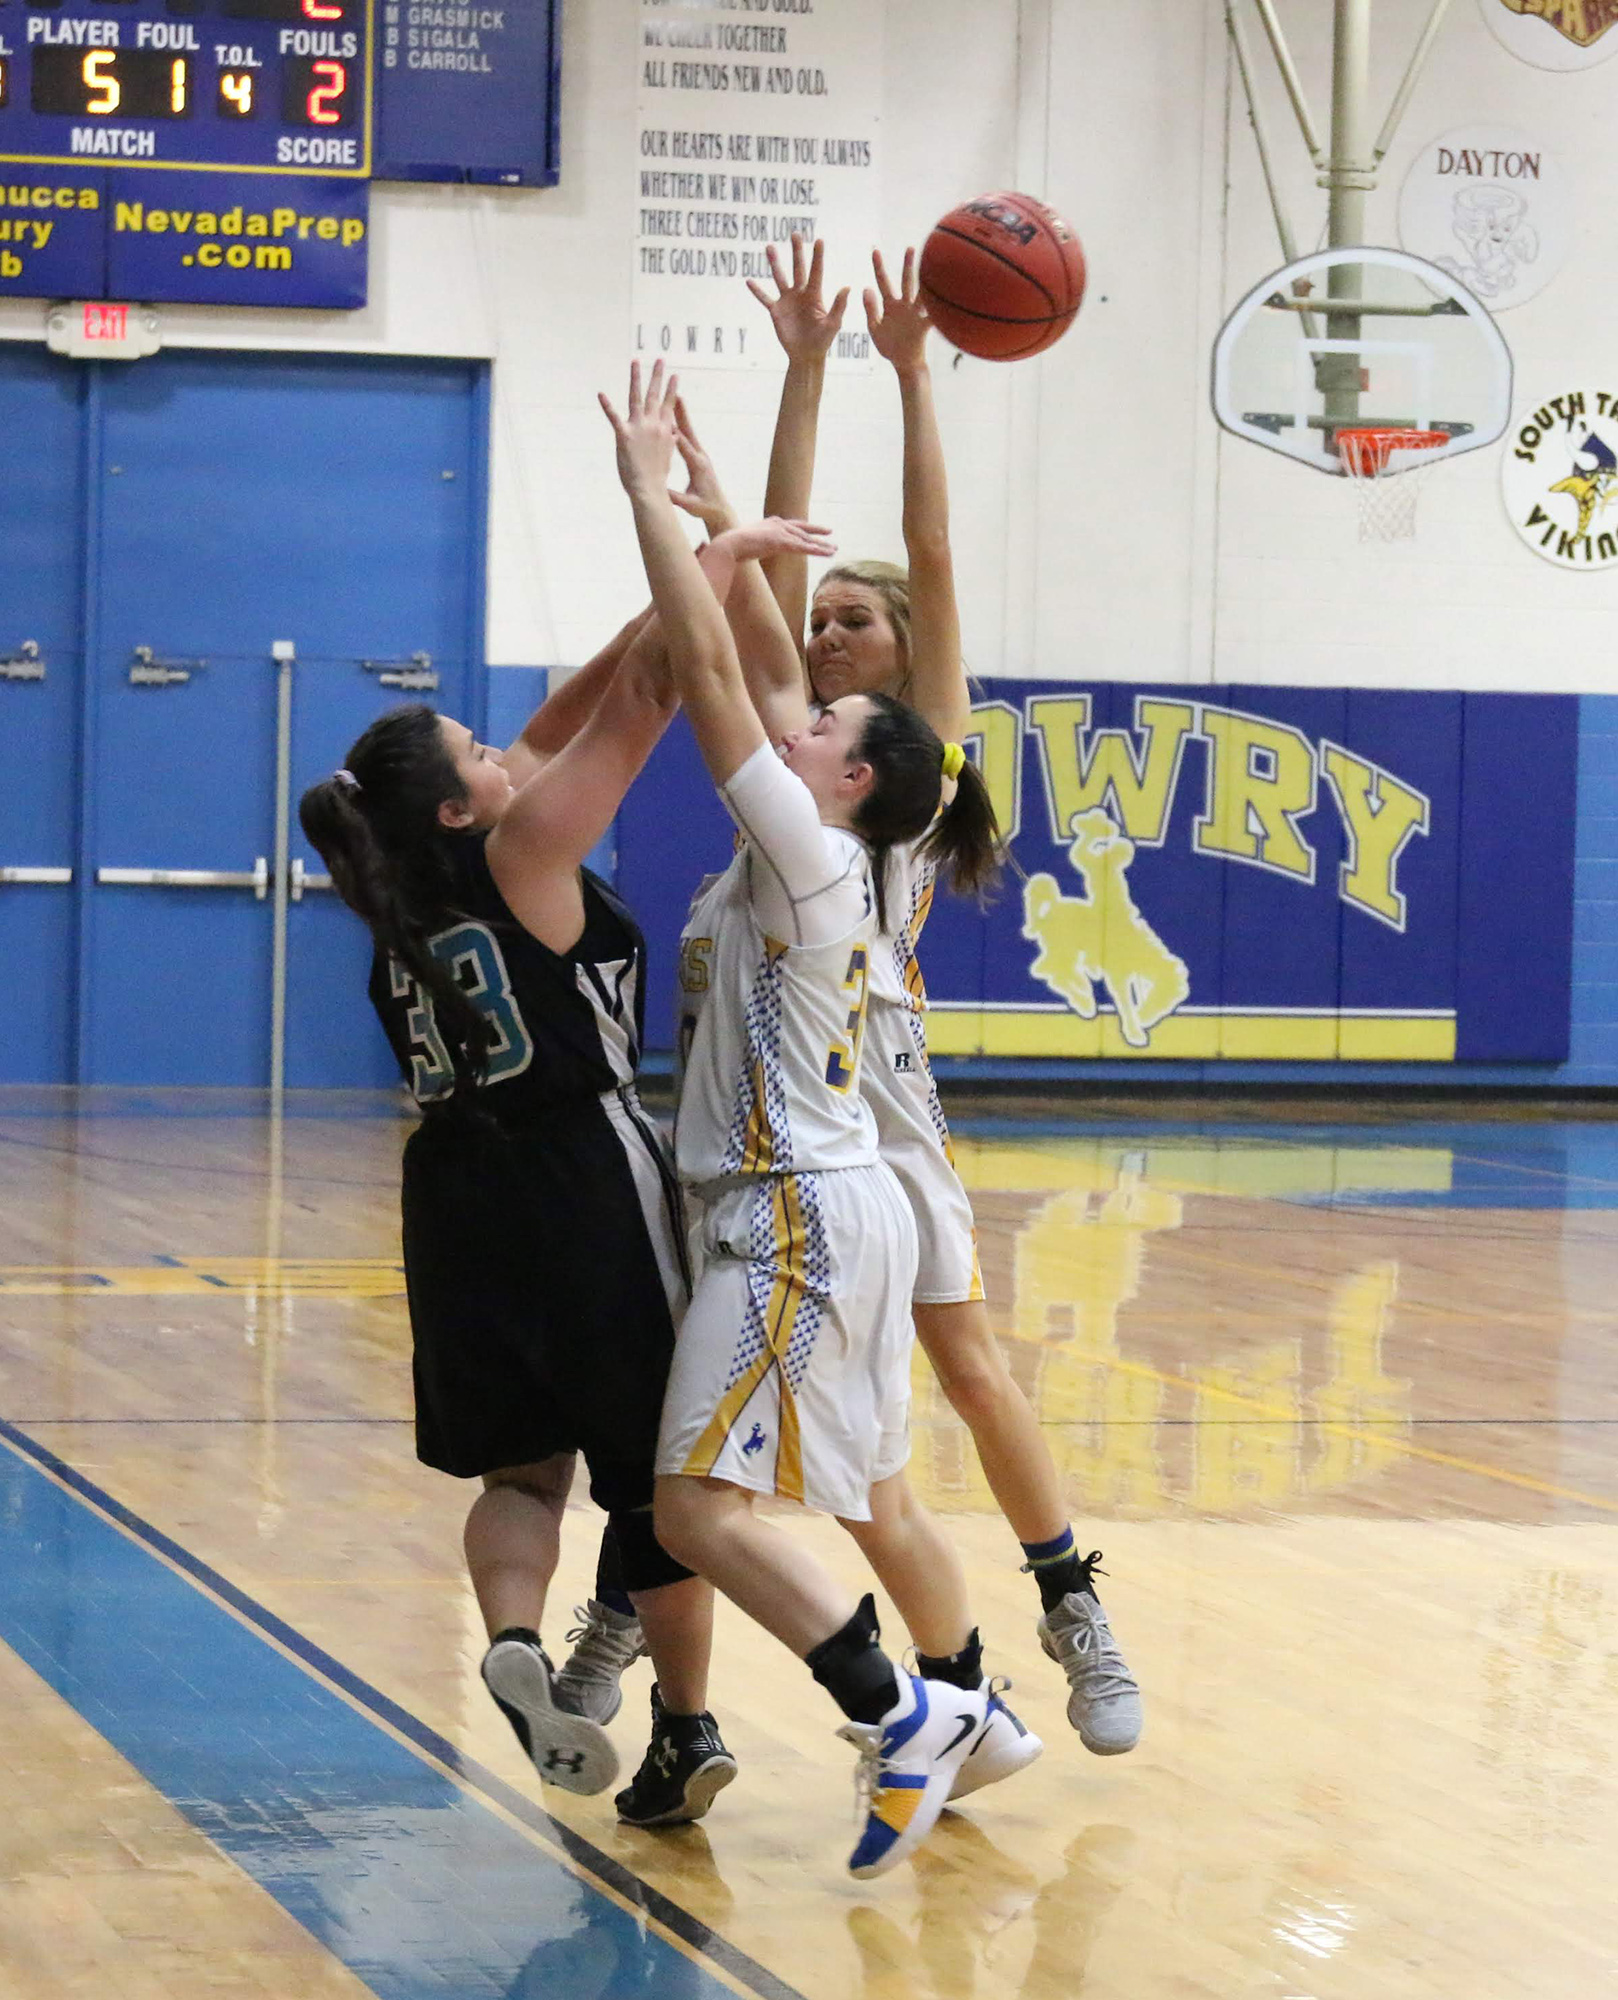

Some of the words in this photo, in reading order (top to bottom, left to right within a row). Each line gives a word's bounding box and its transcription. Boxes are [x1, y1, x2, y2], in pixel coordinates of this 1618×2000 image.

[27, 17, 120, 47] PLAYER
[137, 22, 200, 50] FOUL
[408, 7, 504, 29] GRASMICK
[279, 29, 358, 58] FOULS
[387, 27, 399, 46] B
[408, 28, 480, 49] SIGALA
[717, 23, 787, 53] TOGETHER
[214, 44, 263, 67] T.O.L.
[408, 51, 492, 73] CARROLL
[82, 49, 120, 114] 5
[172, 58, 186, 113] 1
[221, 74, 252, 114] 4
[307, 60, 345, 124] 2
[643, 61, 667, 88] ALL
[672, 62, 729, 91] FRIENDS
[733, 64, 760, 92] NEW
[765, 67, 793, 94] AND
[797, 68, 828, 96] OLD.
[71, 127, 155, 156] MATCH
[277, 137, 357, 164] SCORE
[641, 130, 668, 157] OUR
[672, 131, 723, 160] HEARTS
[726, 134, 751, 161] ARE
[756, 135, 789, 163] WITH
[794, 138, 818, 165] YOU
[822, 138, 871, 167] ALWAYS
[1436, 148, 1541, 180] DAYTON
[0, 185, 100, 210] ucca
[641, 170, 704, 199] WHETHER
[708, 174, 727, 200] WE
[731, 175, 755, 203] WIN
[760, 177, 778, 204] OR
[783, 178, 820, 206] LOSE.
[115, 202, 365, 247] NevadaPrep
[641, 208, 682, 236] THREE
[686, 211, 738, 240] CHEERS
[743, 214, 767, 241] FOR
[182, 243, 293, 270] .com
[641, 247, 664, 273] THE
[669, 249, 706, 275] GOLD
[710, 251, 737, 278] AND
[84, 304, 129, 340] EXIT
[837, 332, 869, 359] HIGH
[1514, 391, 1585, 463] SOUTH
[1525, 503, 1618, 562] VIKIN
